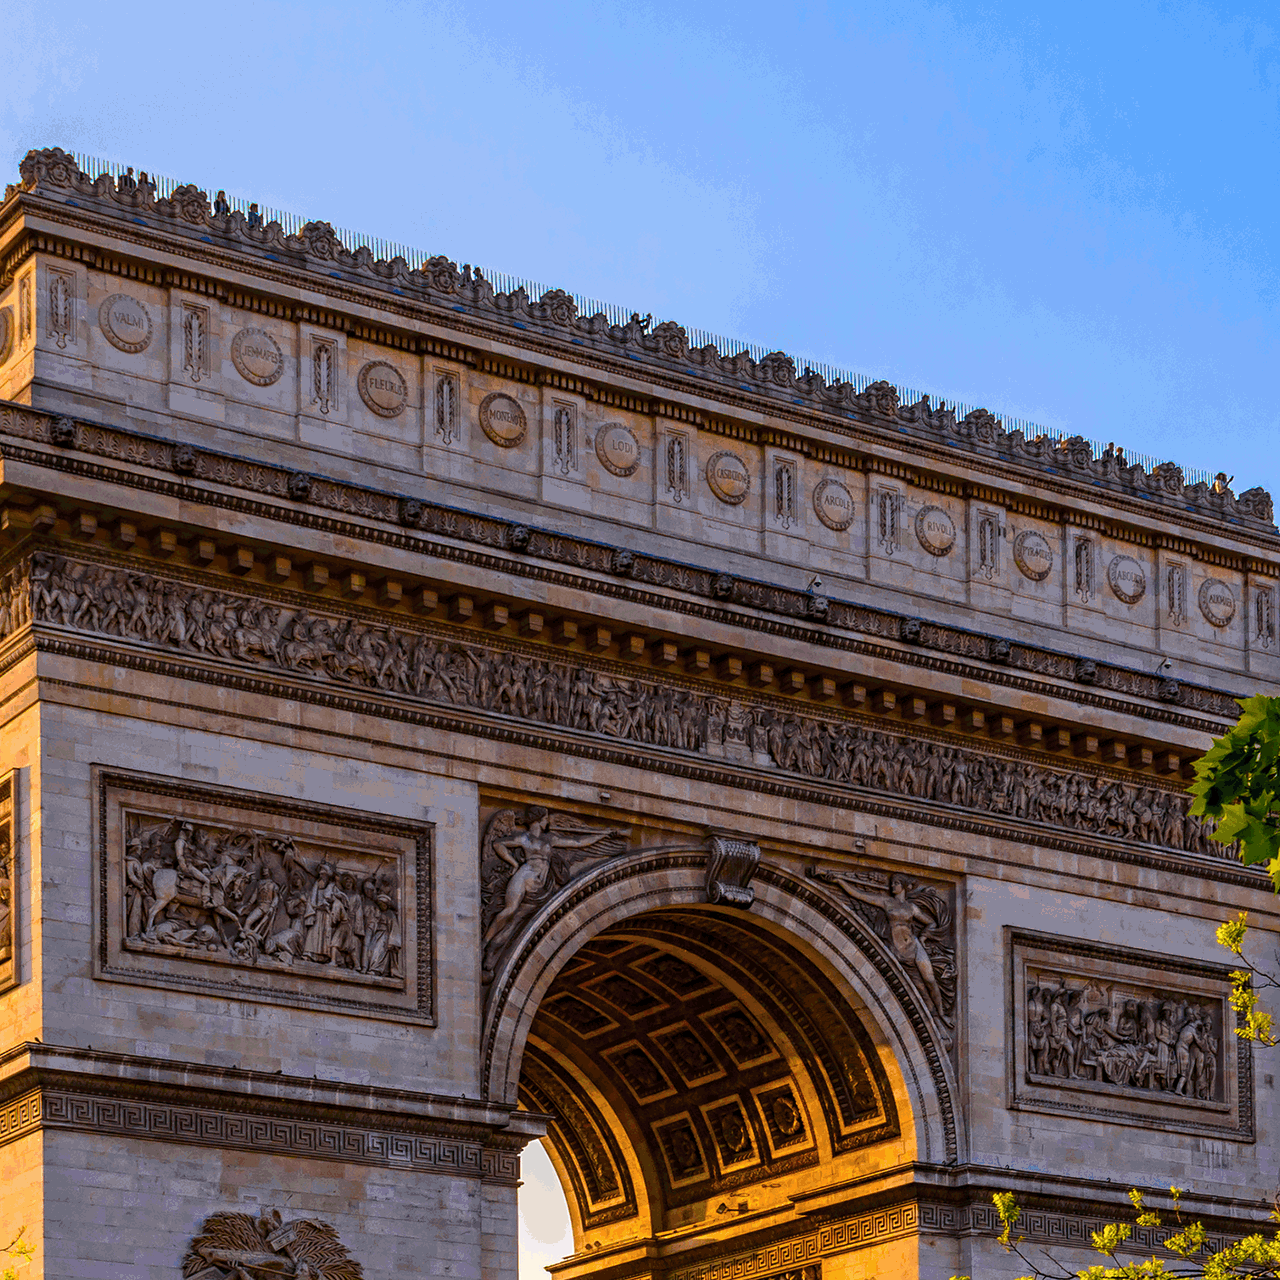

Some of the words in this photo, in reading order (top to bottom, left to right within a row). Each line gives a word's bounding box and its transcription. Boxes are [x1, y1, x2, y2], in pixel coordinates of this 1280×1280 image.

[113, 311, 145, 330] VALMI
[369, 377, 403, 396] FLEURUS
[612, 439, 634, 455] LODI
[824, 495, 851, 510] ARCOLE
[927, 521, 952, 536] RIVOLI
